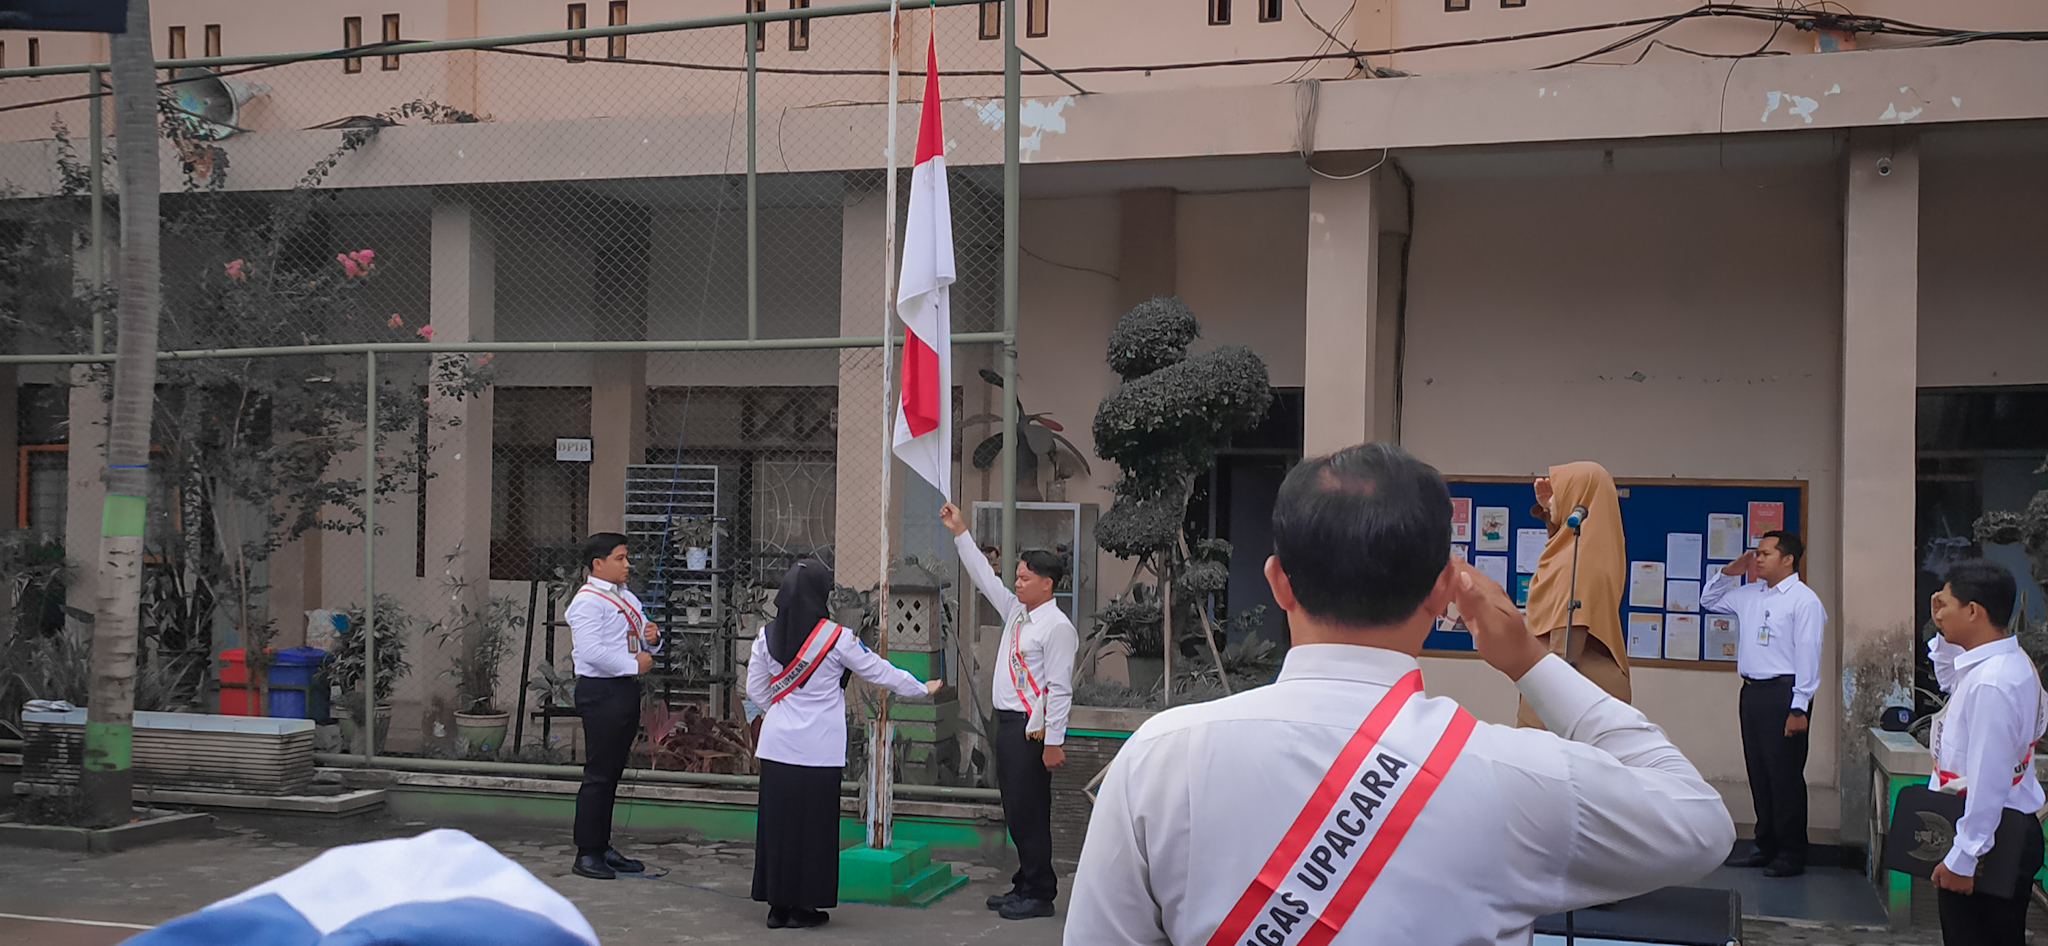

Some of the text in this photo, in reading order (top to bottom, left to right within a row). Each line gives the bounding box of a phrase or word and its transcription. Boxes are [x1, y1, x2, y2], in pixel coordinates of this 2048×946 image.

[783, 660, 809, 686] UPACARA
[1246, 752, 1408, 946] GAS UPACARA
